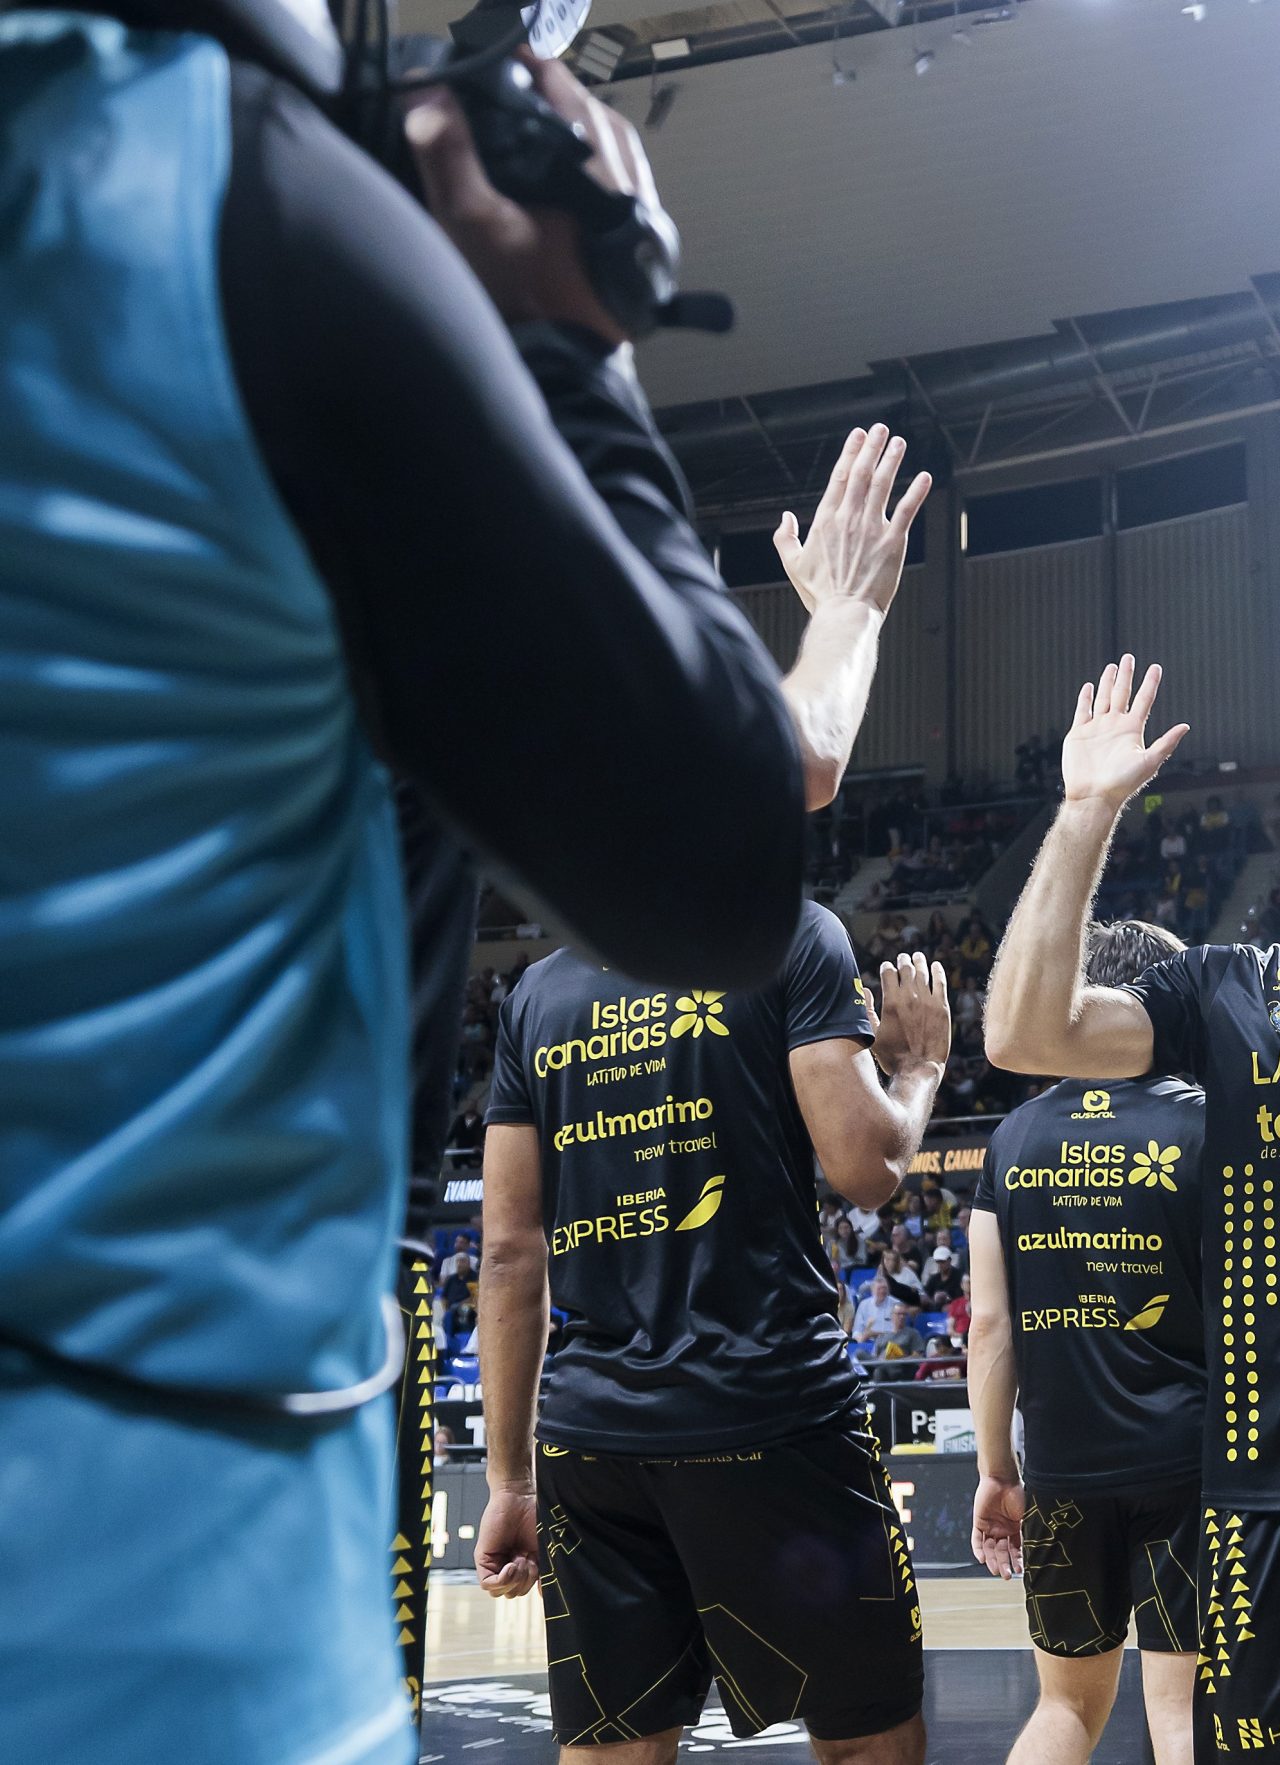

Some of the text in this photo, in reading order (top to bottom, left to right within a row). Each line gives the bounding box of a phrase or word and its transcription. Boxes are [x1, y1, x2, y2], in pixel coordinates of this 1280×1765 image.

[592, 993, 668, 1030] Islas
[534, 1022, 667, 1078] Canarias
[586, 1057, 667, 1086] LATITUD DE VIDA
[634, 1132, 717, 1162] new travel
[1060, 1140, 1126, 1164] Islas
[1005, 1163, 1124, 1191] Canarias
[616, 1187, 666, 1207] IBERIA
[1052, 1195, 1123, 1207] LATITUD DE VIDA
[552, 1205, 669, 1256] EXPRESS
[1017, 1226, 1163, 1251] azulmarino
[1086, 1261, 1163, 1275] new travel
[1078, 1294, 1116, 1305] IBERIA
[1021, 1307, 1120, 1332] EXPRESS
